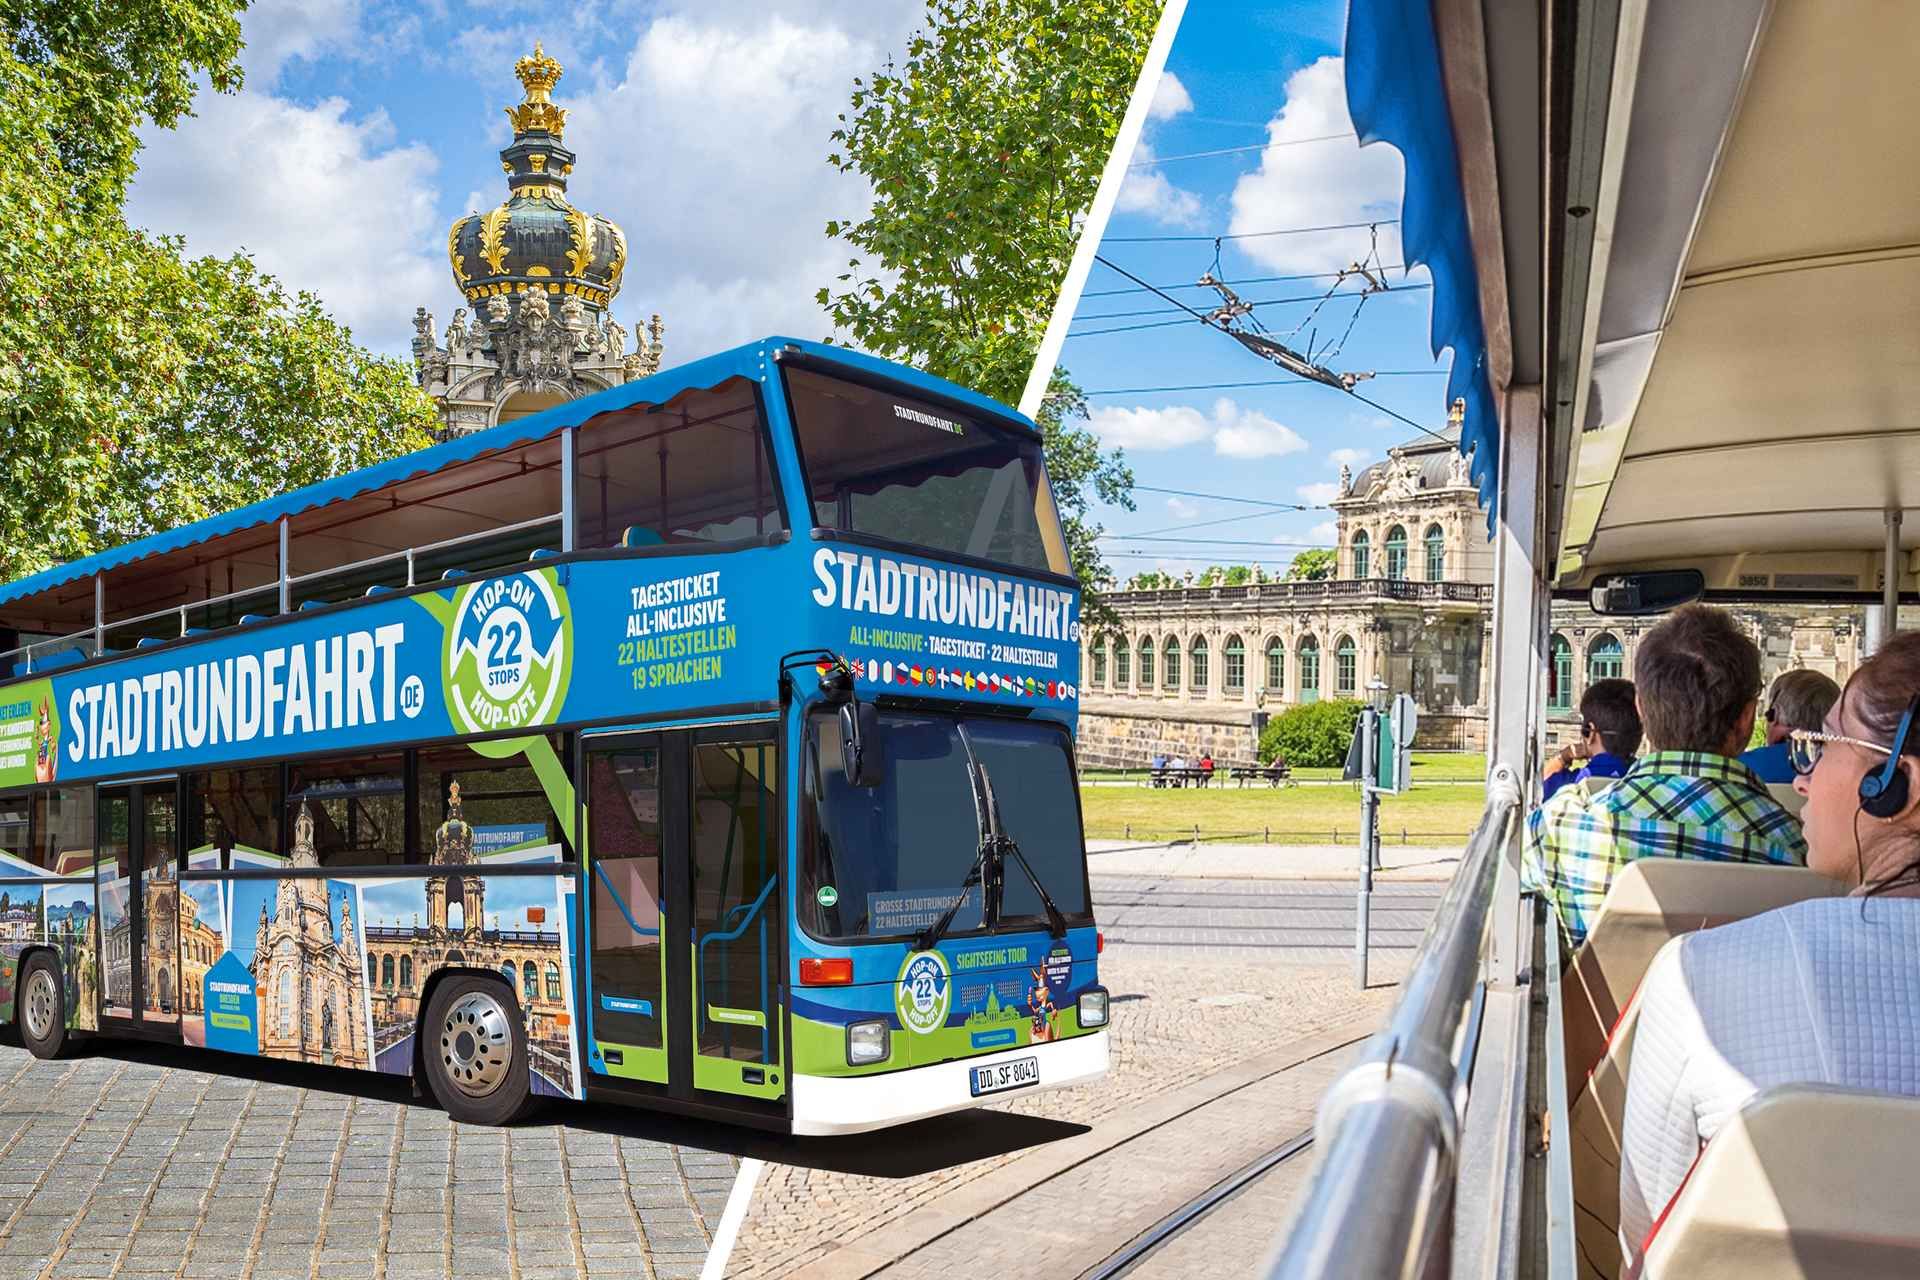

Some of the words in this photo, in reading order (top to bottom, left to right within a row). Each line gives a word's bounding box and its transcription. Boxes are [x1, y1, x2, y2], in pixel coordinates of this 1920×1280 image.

[472, 579, 535, 623] HOP-ON
[631, 571, 720, 610] TAGESTICKET
[812, 547, 1073, 642] STADTRUNDFAHRT
[626, 598, 727, 638] ALL-INCLUSIVE
[487, 620, 522, 669] 22
[618, 641, 634, 665] 22
[636, 624, 737, 663] HALTESTELLEN
[929, 635, 987, 661] TAGESTICKET
[991, 644, 1002, 663] 22
[1002, 646, 1059, 670] HALTESTELLEN
[488, 667, 520, 687] STOPS
[631, 666, 647, 691] 19
[648, 655, 722, 688] SPRACHEN
[68, 622, 404, 764] STADTRUNDFAHRT
[470, 682, 537, 729] HOP-OFF
[875, 900, 904, 914] GROSSE
[875, 915, 886, 928] 22
[910, 960, 940, 979] HOP-ON
[956, 948, 1008, 970] SIGHTSEEING
[1007, 947, 1028, 963] TOUR
[916, 979, 931, 999] 22
[908, 1005, 939, 1026] HOP-OFF
[979, 1069, 994, 1089] DD
[999, 1066, 1011, 1085] SF
[1013, 1060, 1037, 1082] 8041
